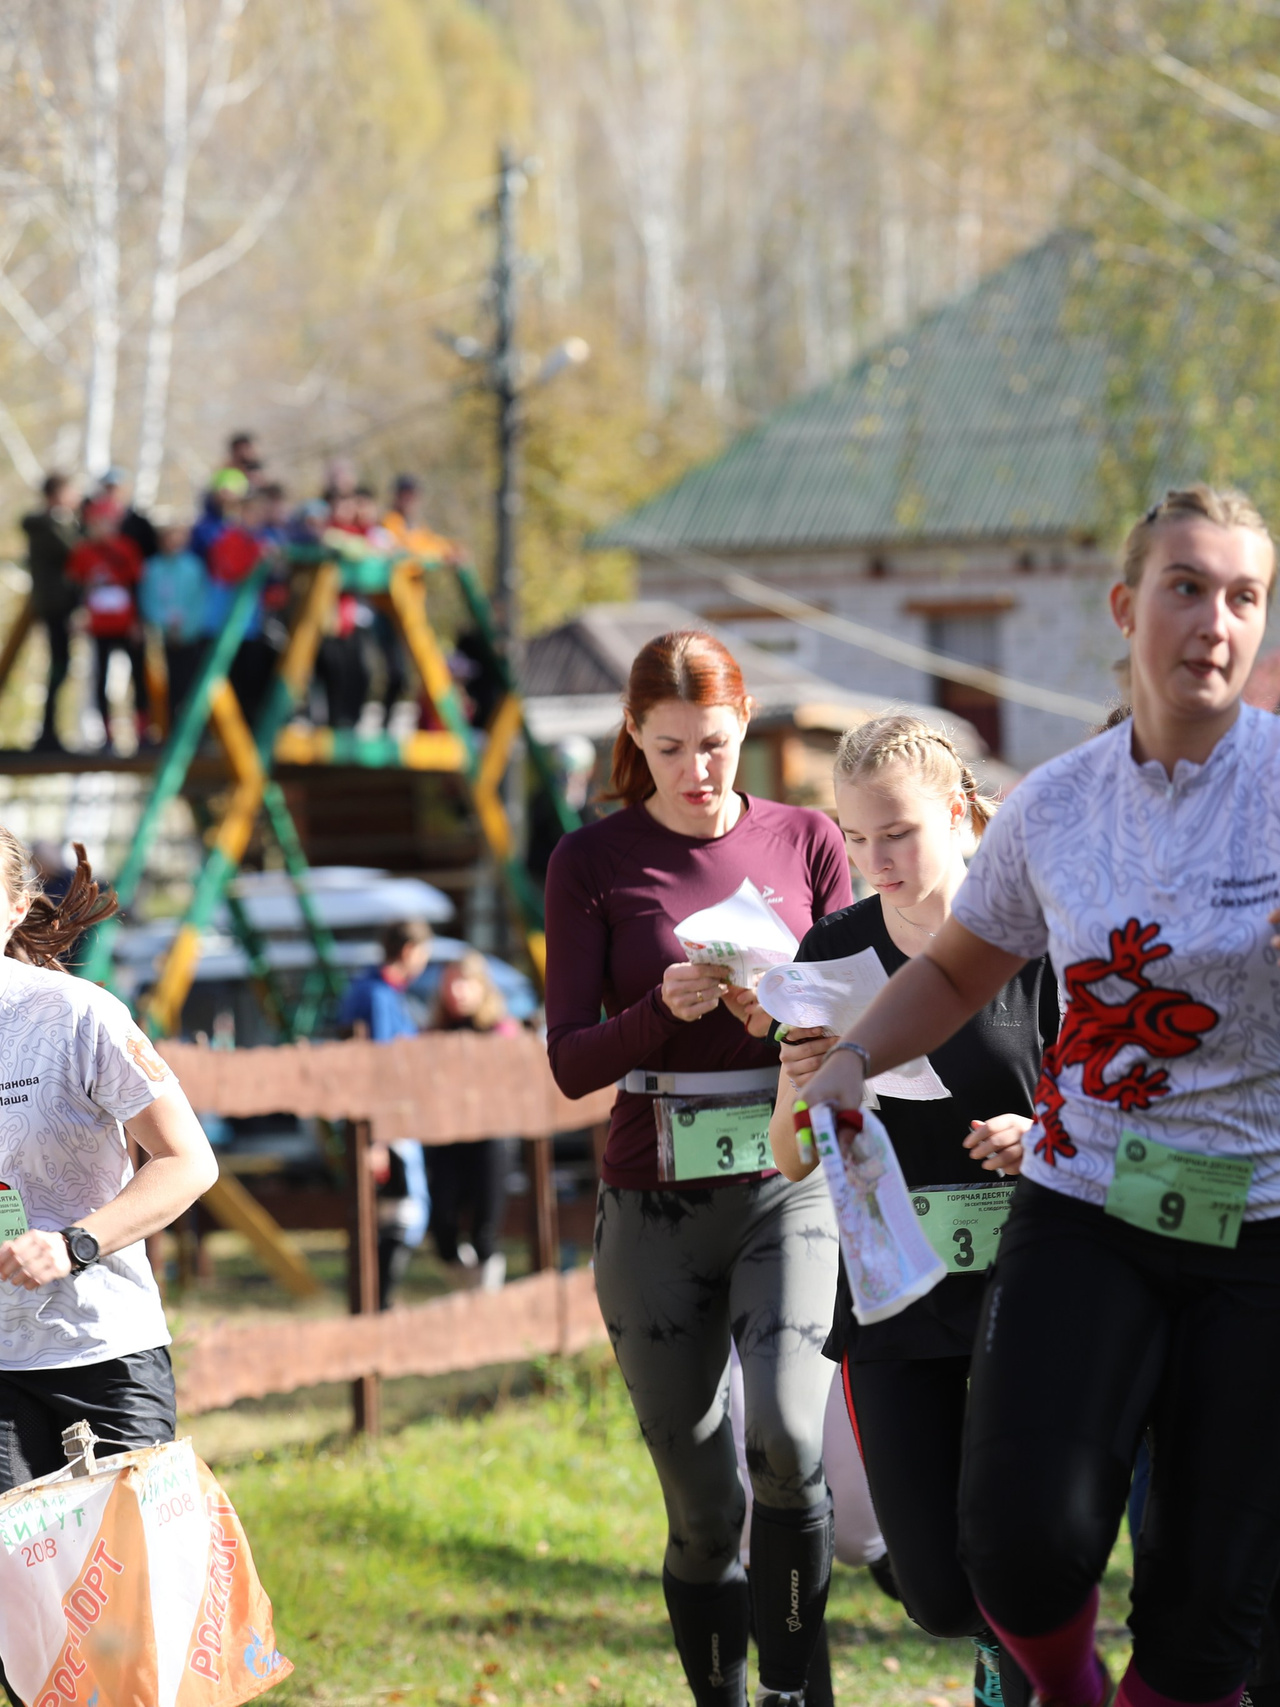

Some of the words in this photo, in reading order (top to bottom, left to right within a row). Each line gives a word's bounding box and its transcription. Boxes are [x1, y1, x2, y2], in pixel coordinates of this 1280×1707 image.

[0, 1076, 40, 1091] панова
[716, 1136, 735, 1170] 3
[757, 1141, 767, 1166] 2
[947, 1193, 980, 1202] ГОРЯЧАЯ
[953, 1218, 979, 1226] Озерск
[1156, 1192, 1185, 1231] 9
[5, 1228, 25, 1236] ЭТАП
[1218, 1213, 1229, 1241] 1
[952, 1227, 975, 1268] 3
[791, 1569, 799, 1616] NORD
